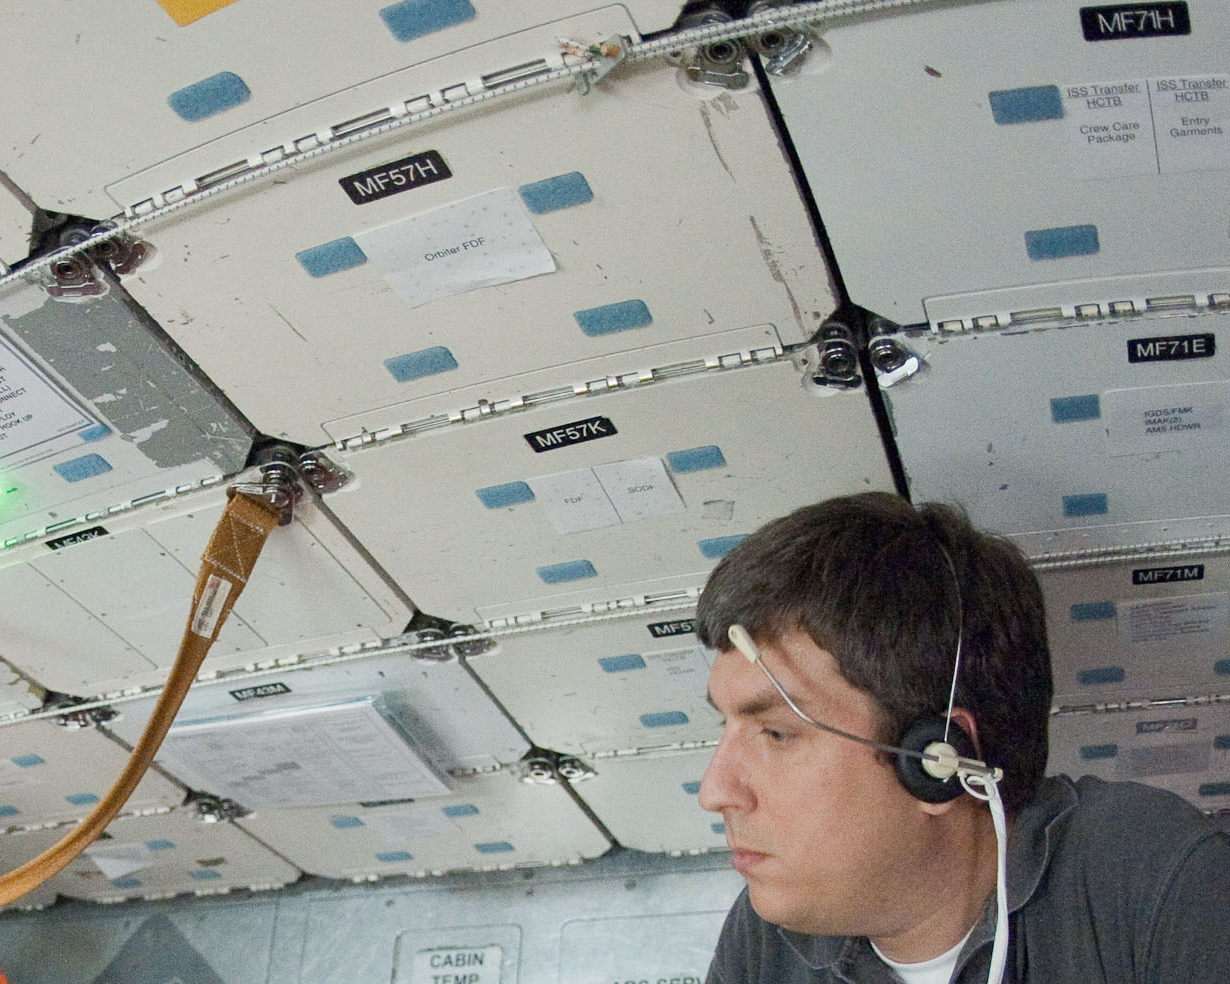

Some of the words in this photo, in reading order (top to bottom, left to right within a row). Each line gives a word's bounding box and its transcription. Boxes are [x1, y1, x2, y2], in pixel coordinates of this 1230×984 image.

[1097, 10, 1175, 33] MF71H
[1067, 87, 1088, 98] ISS
[1091, 83, 1139, 96] Transfer
[1156, 80, 1177, 91] ISS
[1179, 78, 1226, 89] Transfer
[1086, 96, 1121, 108] HCTB
[1175, 91, 1209, 101] HCTB
[1080, 125, 1109, 135] Crew
[1112, 121, 1140, 131] Care
[1181, 116, 1210, 127] Entry
[1087, 132, 1135, 144] Package
[1170, 126, 1223, 137] Garments
[353, 159, 438, 197] MF57H
[425, 244, 460, 262] Orbiter
[462, 236, 487, 252] FDF
[1136, 339, 1206, 357] MF71E
[535, 420, 607, 448] MF57K
[1138, 567, 1199, 582] MF71M
[654, 622, 692, 635] MF5
[430, 953, 484, 968] CABIN
